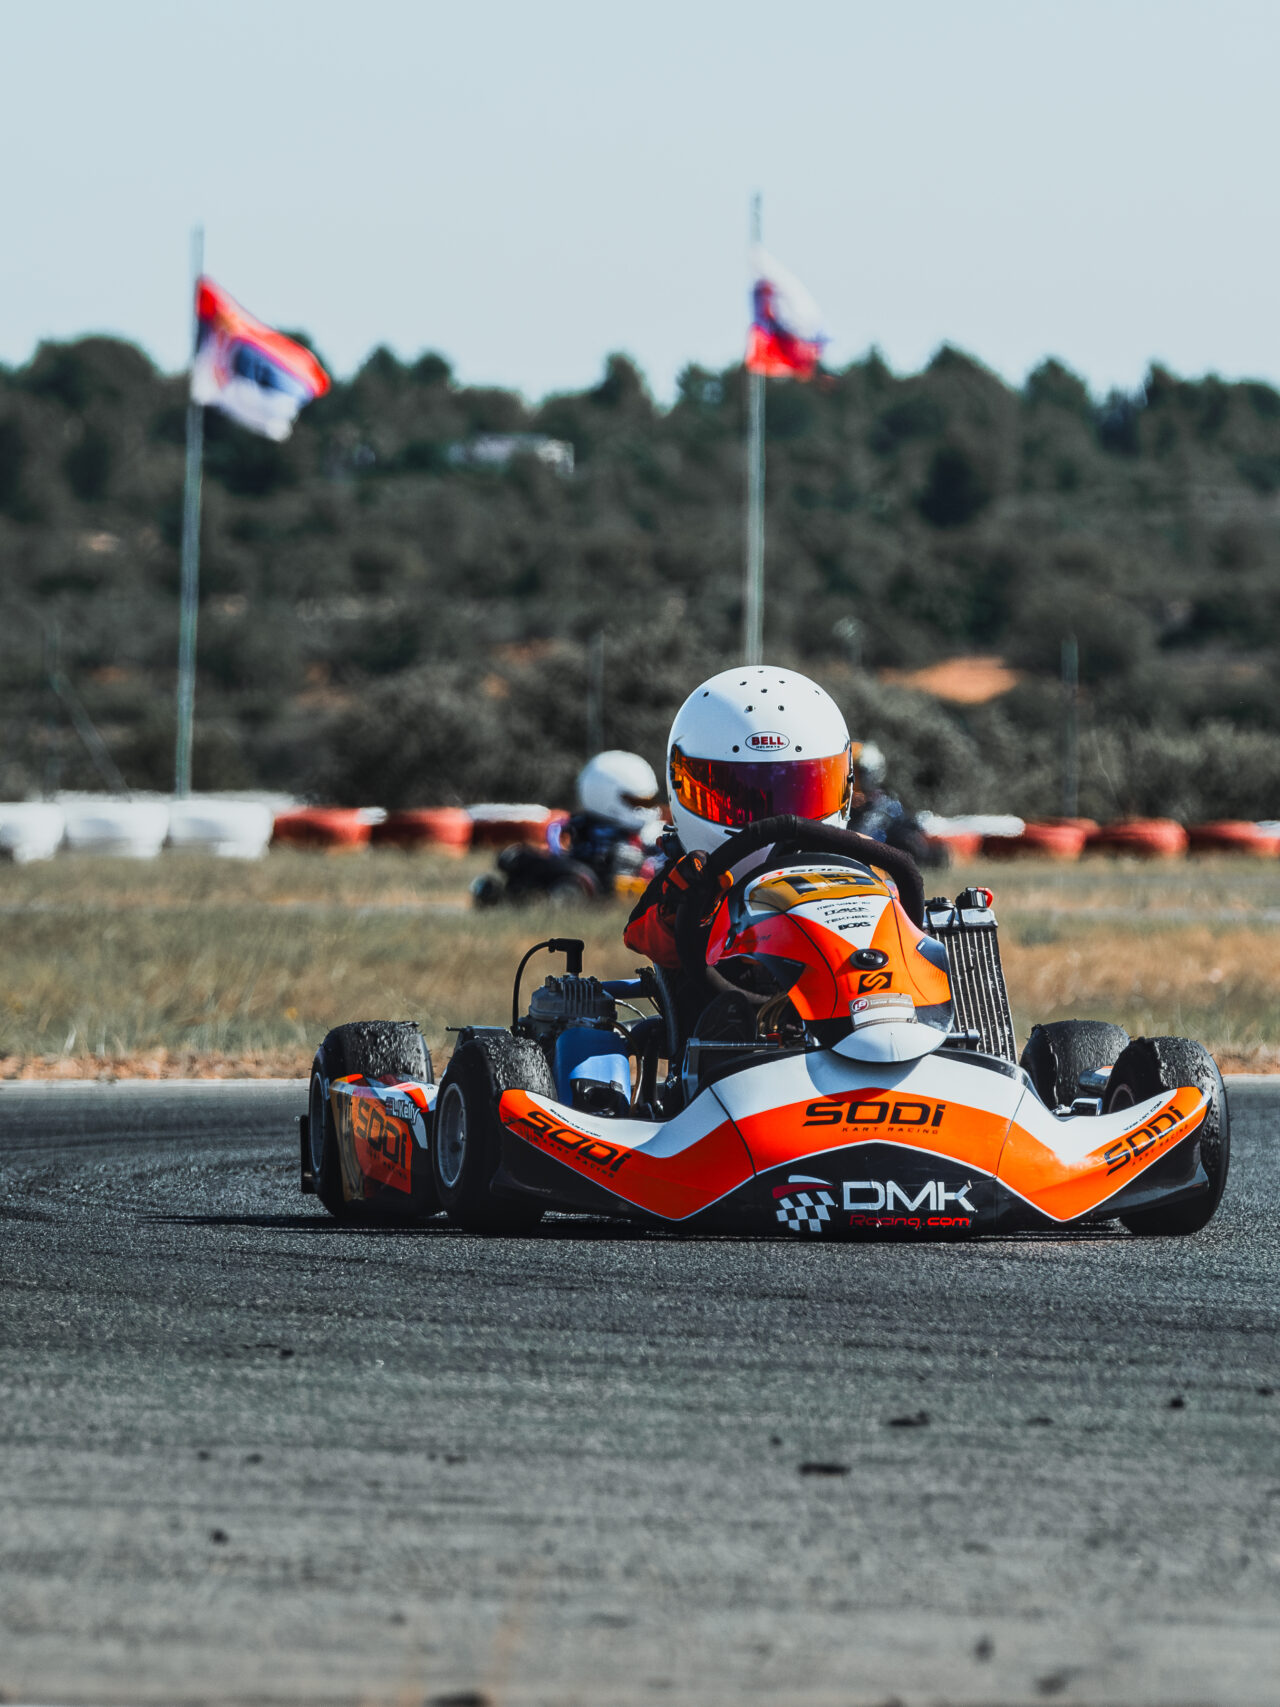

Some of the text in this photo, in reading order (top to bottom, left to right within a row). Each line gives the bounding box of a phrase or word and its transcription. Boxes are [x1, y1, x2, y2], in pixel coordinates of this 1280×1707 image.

[751, 736, 784, 746] BELL
[887, 1127, 939, 1135] RACING
[842, 1180, 976, 1212] DMK
